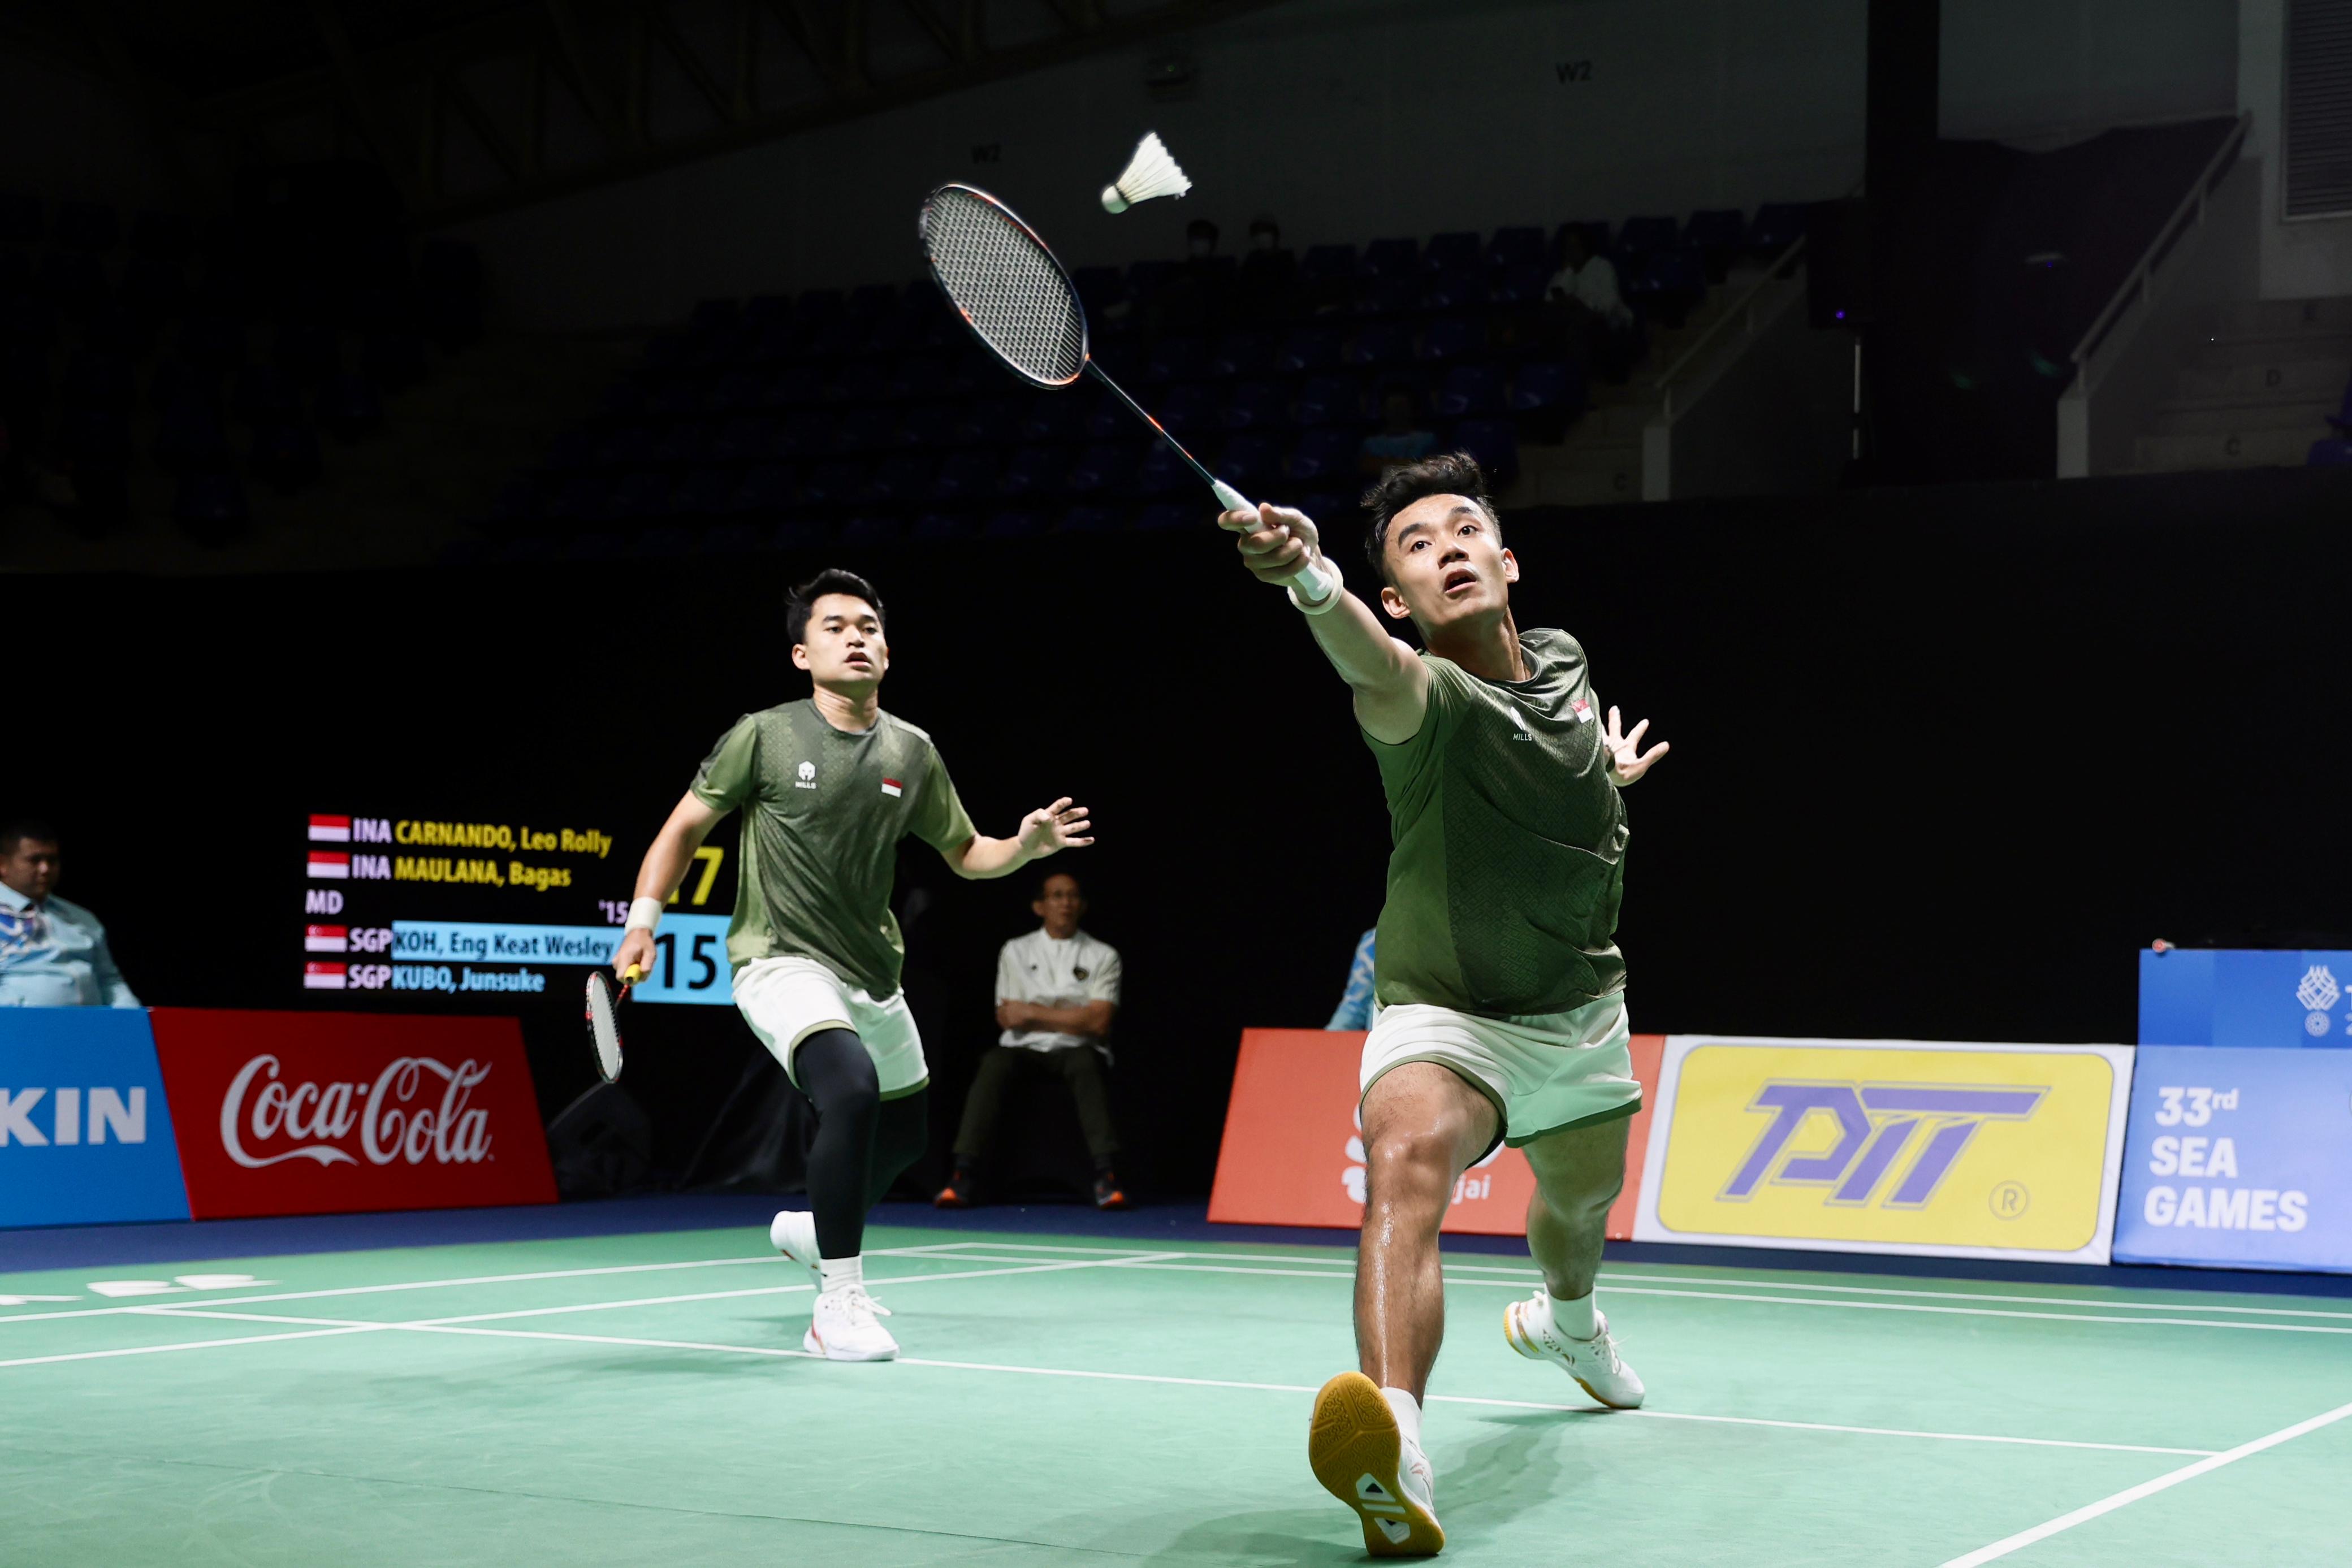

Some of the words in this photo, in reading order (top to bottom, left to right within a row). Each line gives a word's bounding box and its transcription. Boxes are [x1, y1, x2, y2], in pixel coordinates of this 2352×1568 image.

[1556, 61, 1593, 83] W2
[971, 143, 1001, 163] W2
[795, 781, 817, 790] MILLS
[353, 817, 392, 843] INA
[395, 820, 517, 853] CARNANDO,
[520, 826, 558, 851] Leo
[560, 828, 612, 859] Rolly
[352, 854, 391, 880] INA
[395, 856, 505, 887] MAULANA,
[509, 860, 572, 891] Bagas
[305, 889, 344, 915] MD
[349, 928, 393, 953] SGP
[395, 932, 443, 956] KOH,
[451, 932, 487, 961] Eng
[494, 934, 539, 955] Keat
[545, 935, 614, 963] Wesley
[655, 932, 717, 991] 15
[348, 964, 392, 989] SGP
[392, 965, 457, 994] KUBO,
[459, 966, 546, 992] Junsuke
[2155, 1086, 2239, 1127] 33rd
[1715, 1078, 2051, 1211] PTT
[2149, 1136, 2238, 1179] SEA
[2143, 1186, 2308, 1232] GAMES
